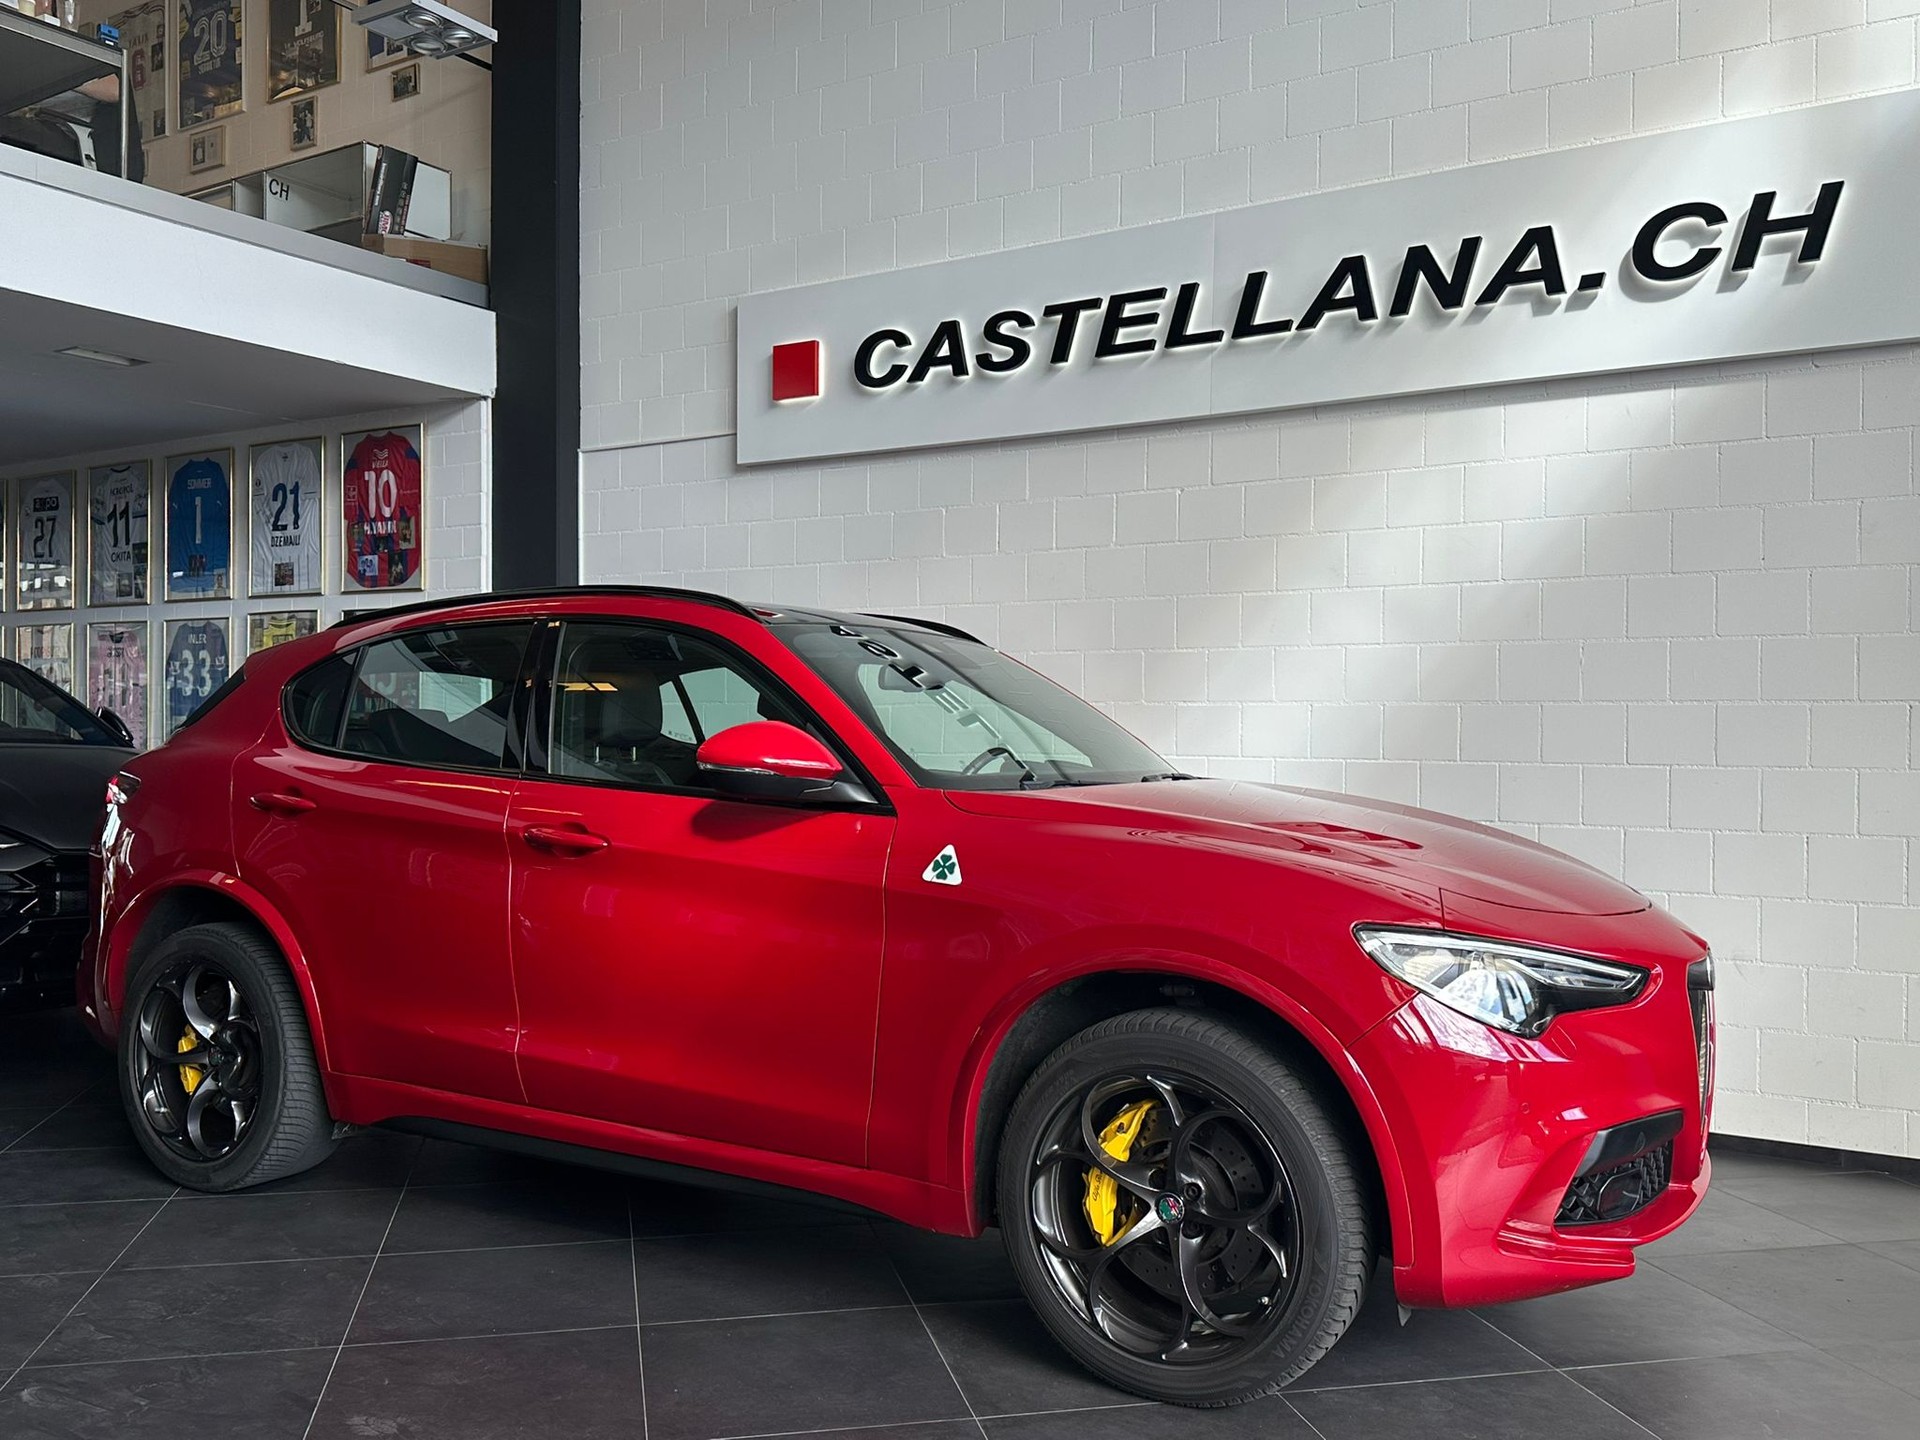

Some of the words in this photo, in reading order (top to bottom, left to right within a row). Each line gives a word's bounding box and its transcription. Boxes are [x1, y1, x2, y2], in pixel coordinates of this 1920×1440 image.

[193, 10, 227, 66] 20
[269, 178, 290, 201] CH
[853, 180, 1845, 389] CASTELLANA.CH
[187, 478, 212, 490] SOMMER
[271, 481, 300, 531] 21
[364, 469, 397, 518] 10
[33, 517, 56, 559] 27
[107, 502, 131, 548] 11
[195, 496, 202, 544] 1
[270, 535, 300, 548] DZEMAILI
[110, 551, 131, 562] OKITA
[188, 633, 207, 645] INLER
[181, 649, 212, 697] 33
